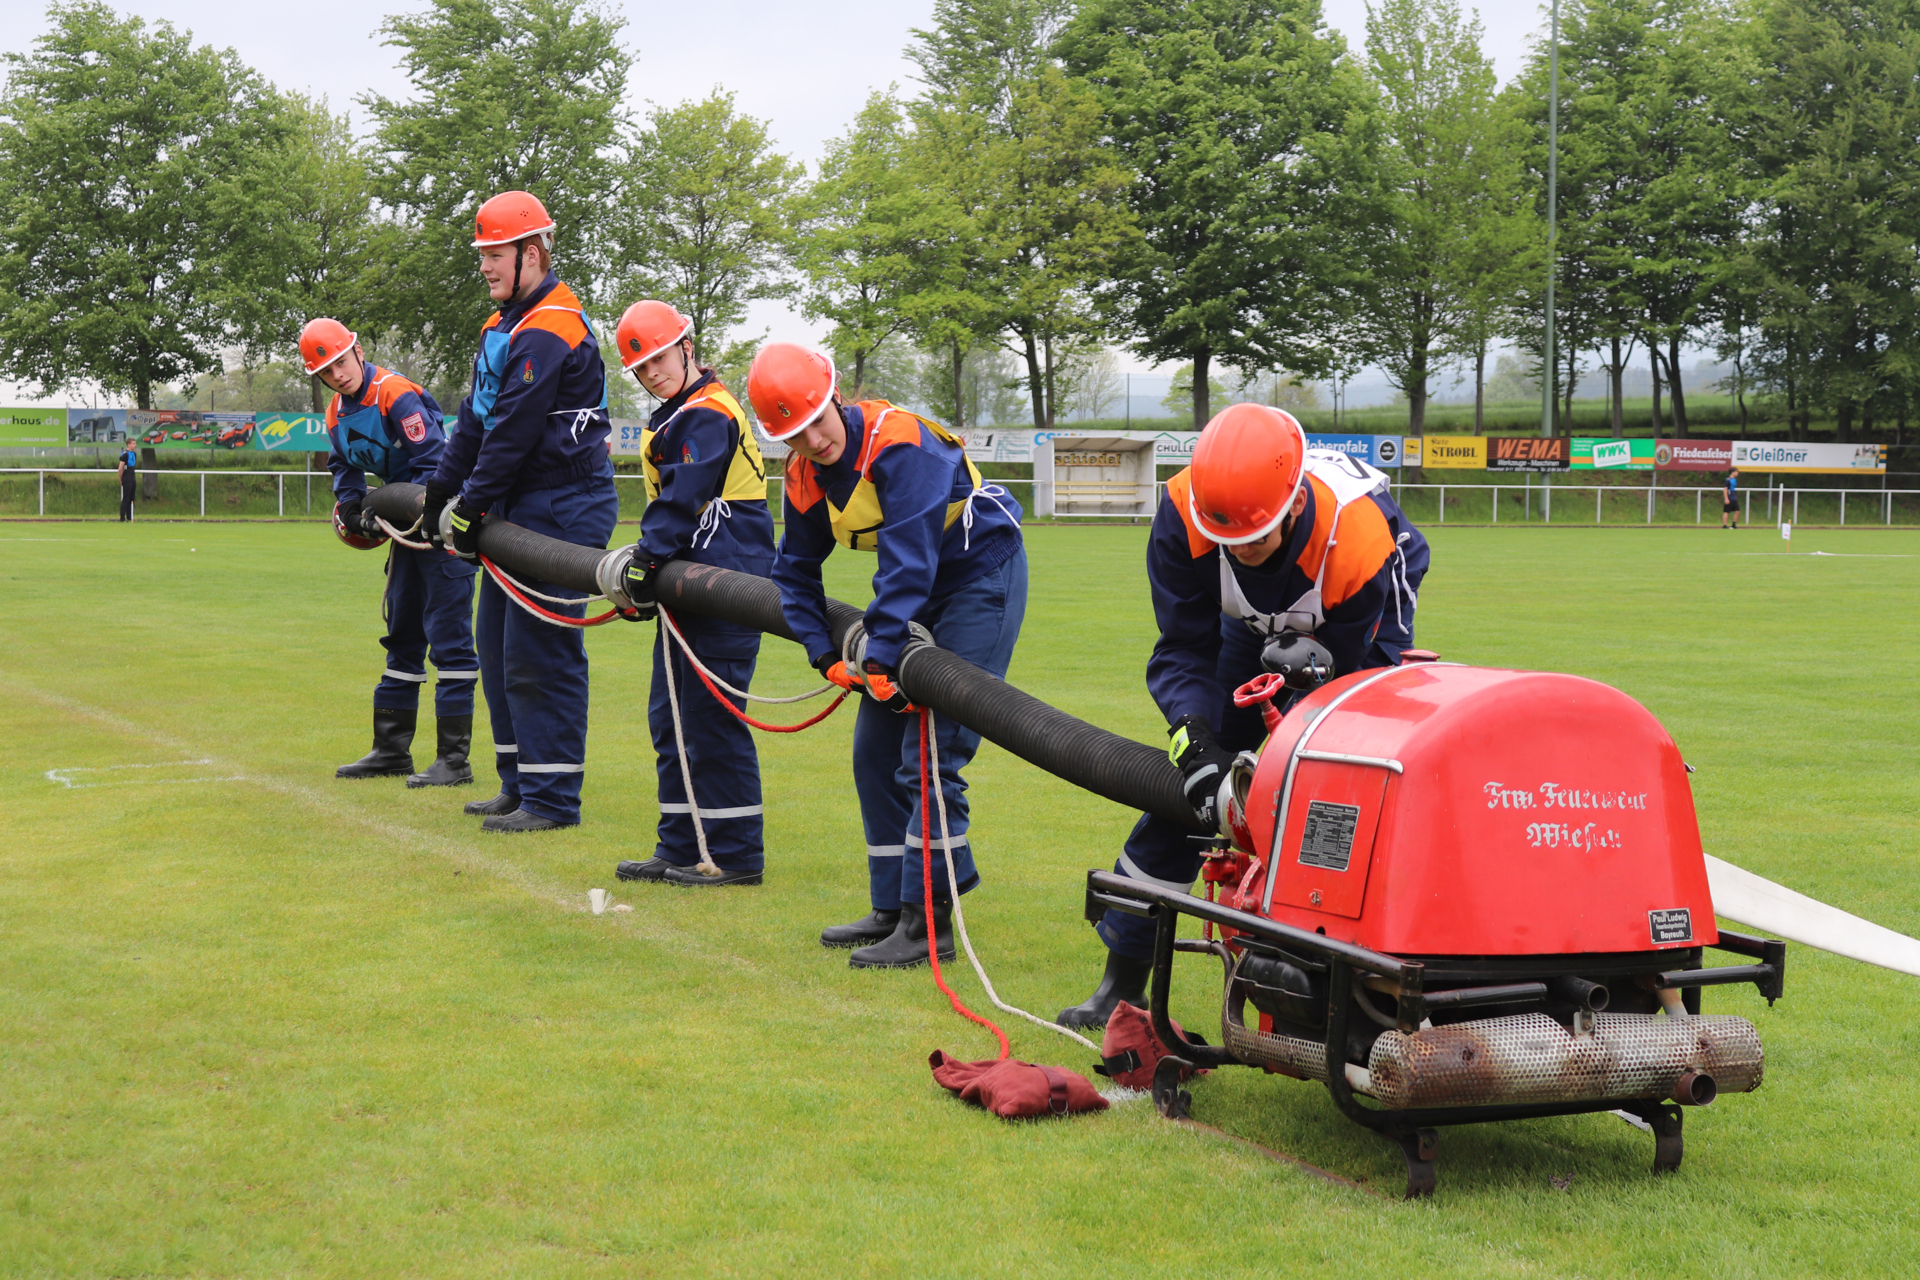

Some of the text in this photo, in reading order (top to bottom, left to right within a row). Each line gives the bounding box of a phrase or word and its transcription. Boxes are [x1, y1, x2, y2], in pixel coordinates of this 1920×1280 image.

[1431, 446, 1479, 458] STROBL
[1497, 438, 1562, 459] WEMA
[1597, 443, 1627, 459] WWK
[1673, 446, 1732, 459] Friedenfelser
[1749, 447, 1808, 462] Gleißner
